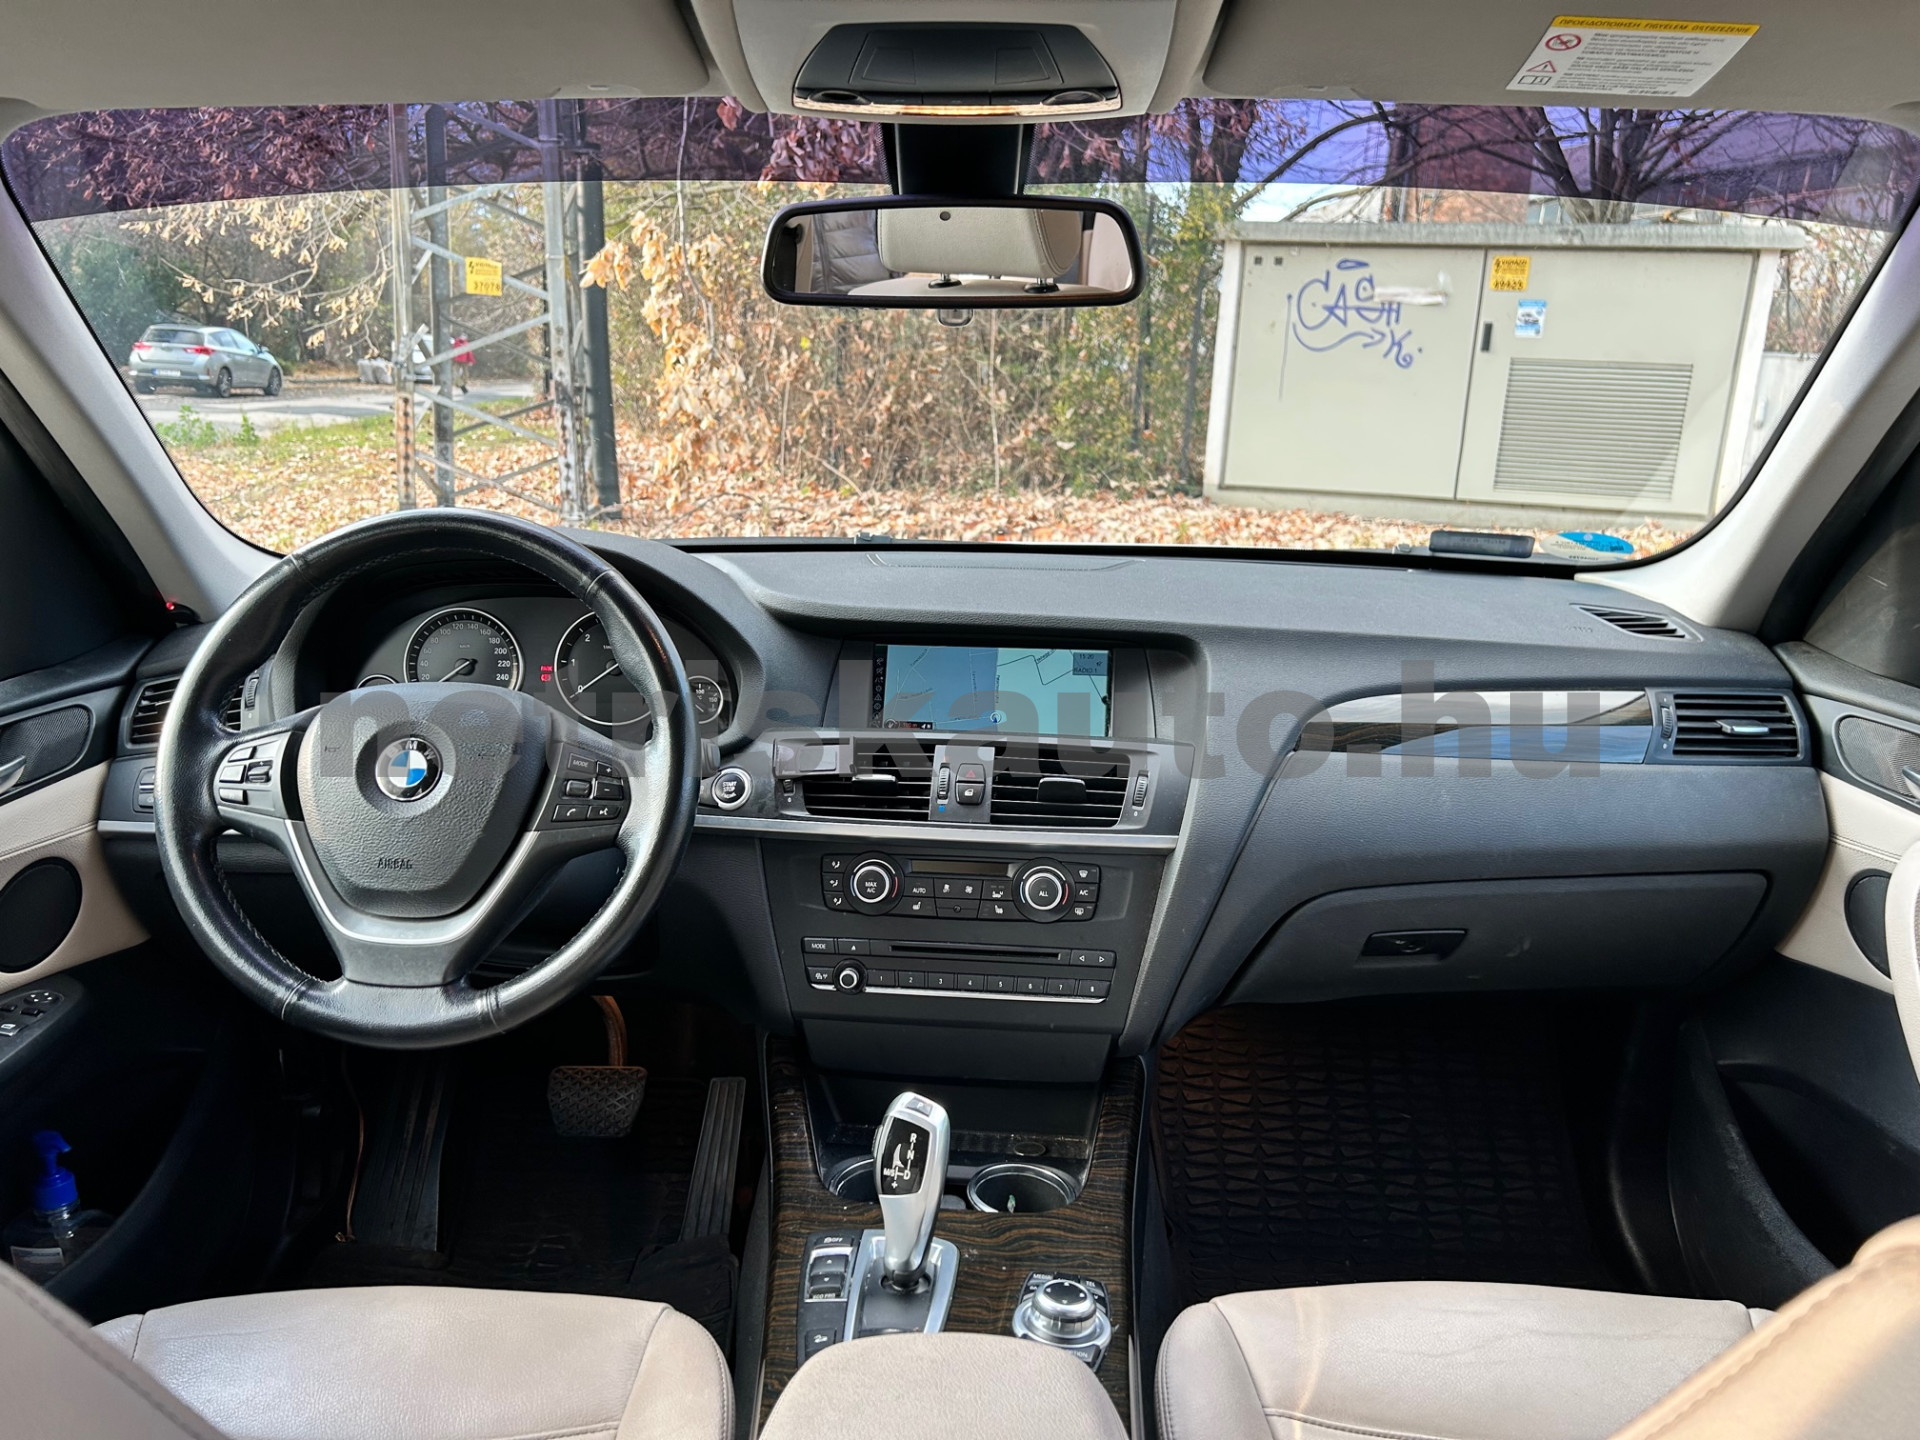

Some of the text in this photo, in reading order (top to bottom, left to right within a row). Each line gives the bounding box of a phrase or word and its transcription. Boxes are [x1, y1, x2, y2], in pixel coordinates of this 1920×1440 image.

[1644, 22, 1689, 30] FIGYELEM
[584, 633, 591, 642] 2
[494, 647, 507, 655] 200
[497, 660, 511, 668] 220
[421, 673, 430, 681] 20
[496, 673, 509, 681] 240
[572, 759, 590, 768] MODE
[377, 857, 413, 870] AIRBAG
[909, 1132, 918, 1144] R
[906, 1150, 915, 1161] N
[903, 1170, 912, 1181] D
[1085, 1280, 1096, 1288] TEL
